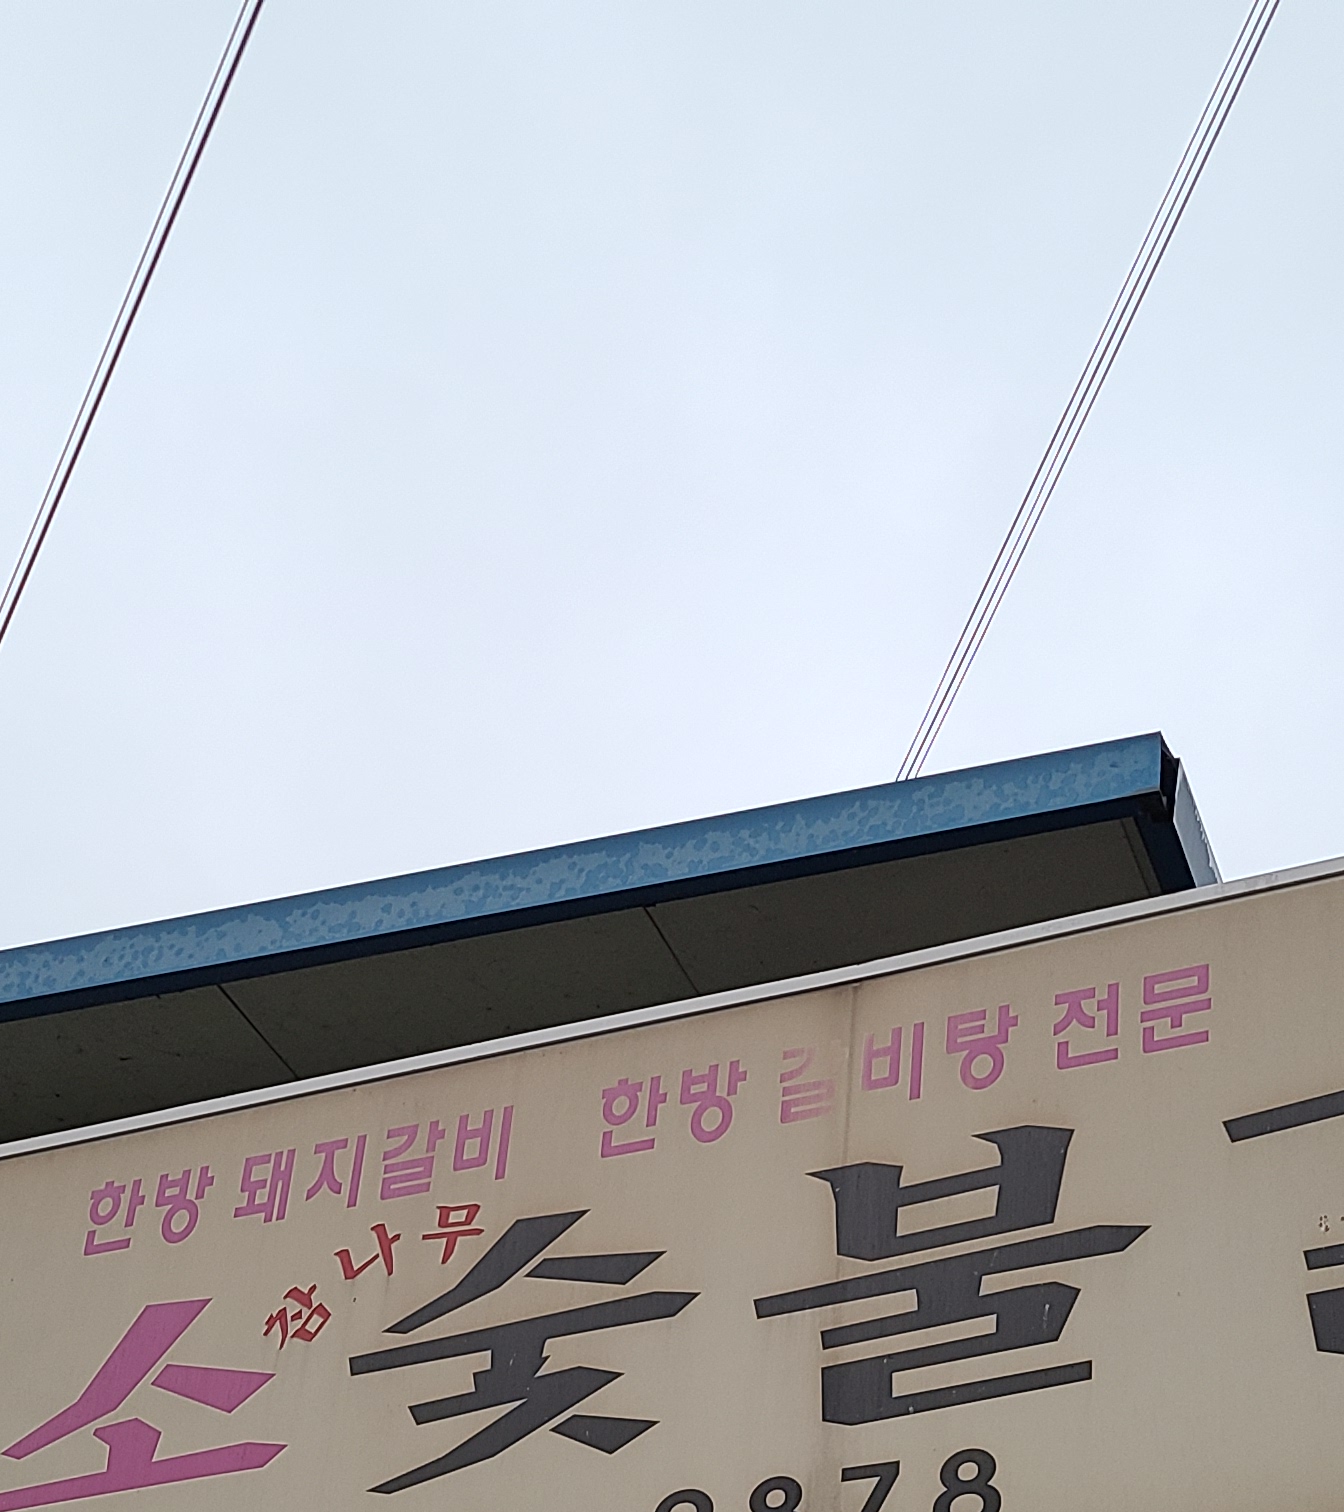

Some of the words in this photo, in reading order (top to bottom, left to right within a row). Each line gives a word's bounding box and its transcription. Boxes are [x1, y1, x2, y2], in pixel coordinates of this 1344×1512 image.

[83, 1165, 214, 1256] 한방
[233, 1105, 515, 1223] 돼지갈비
[599, 1060, 747, 1158] 한방
[1053, 963, 1214, 1071] 전문
[262, 1203, 485, 1350] 참나무
